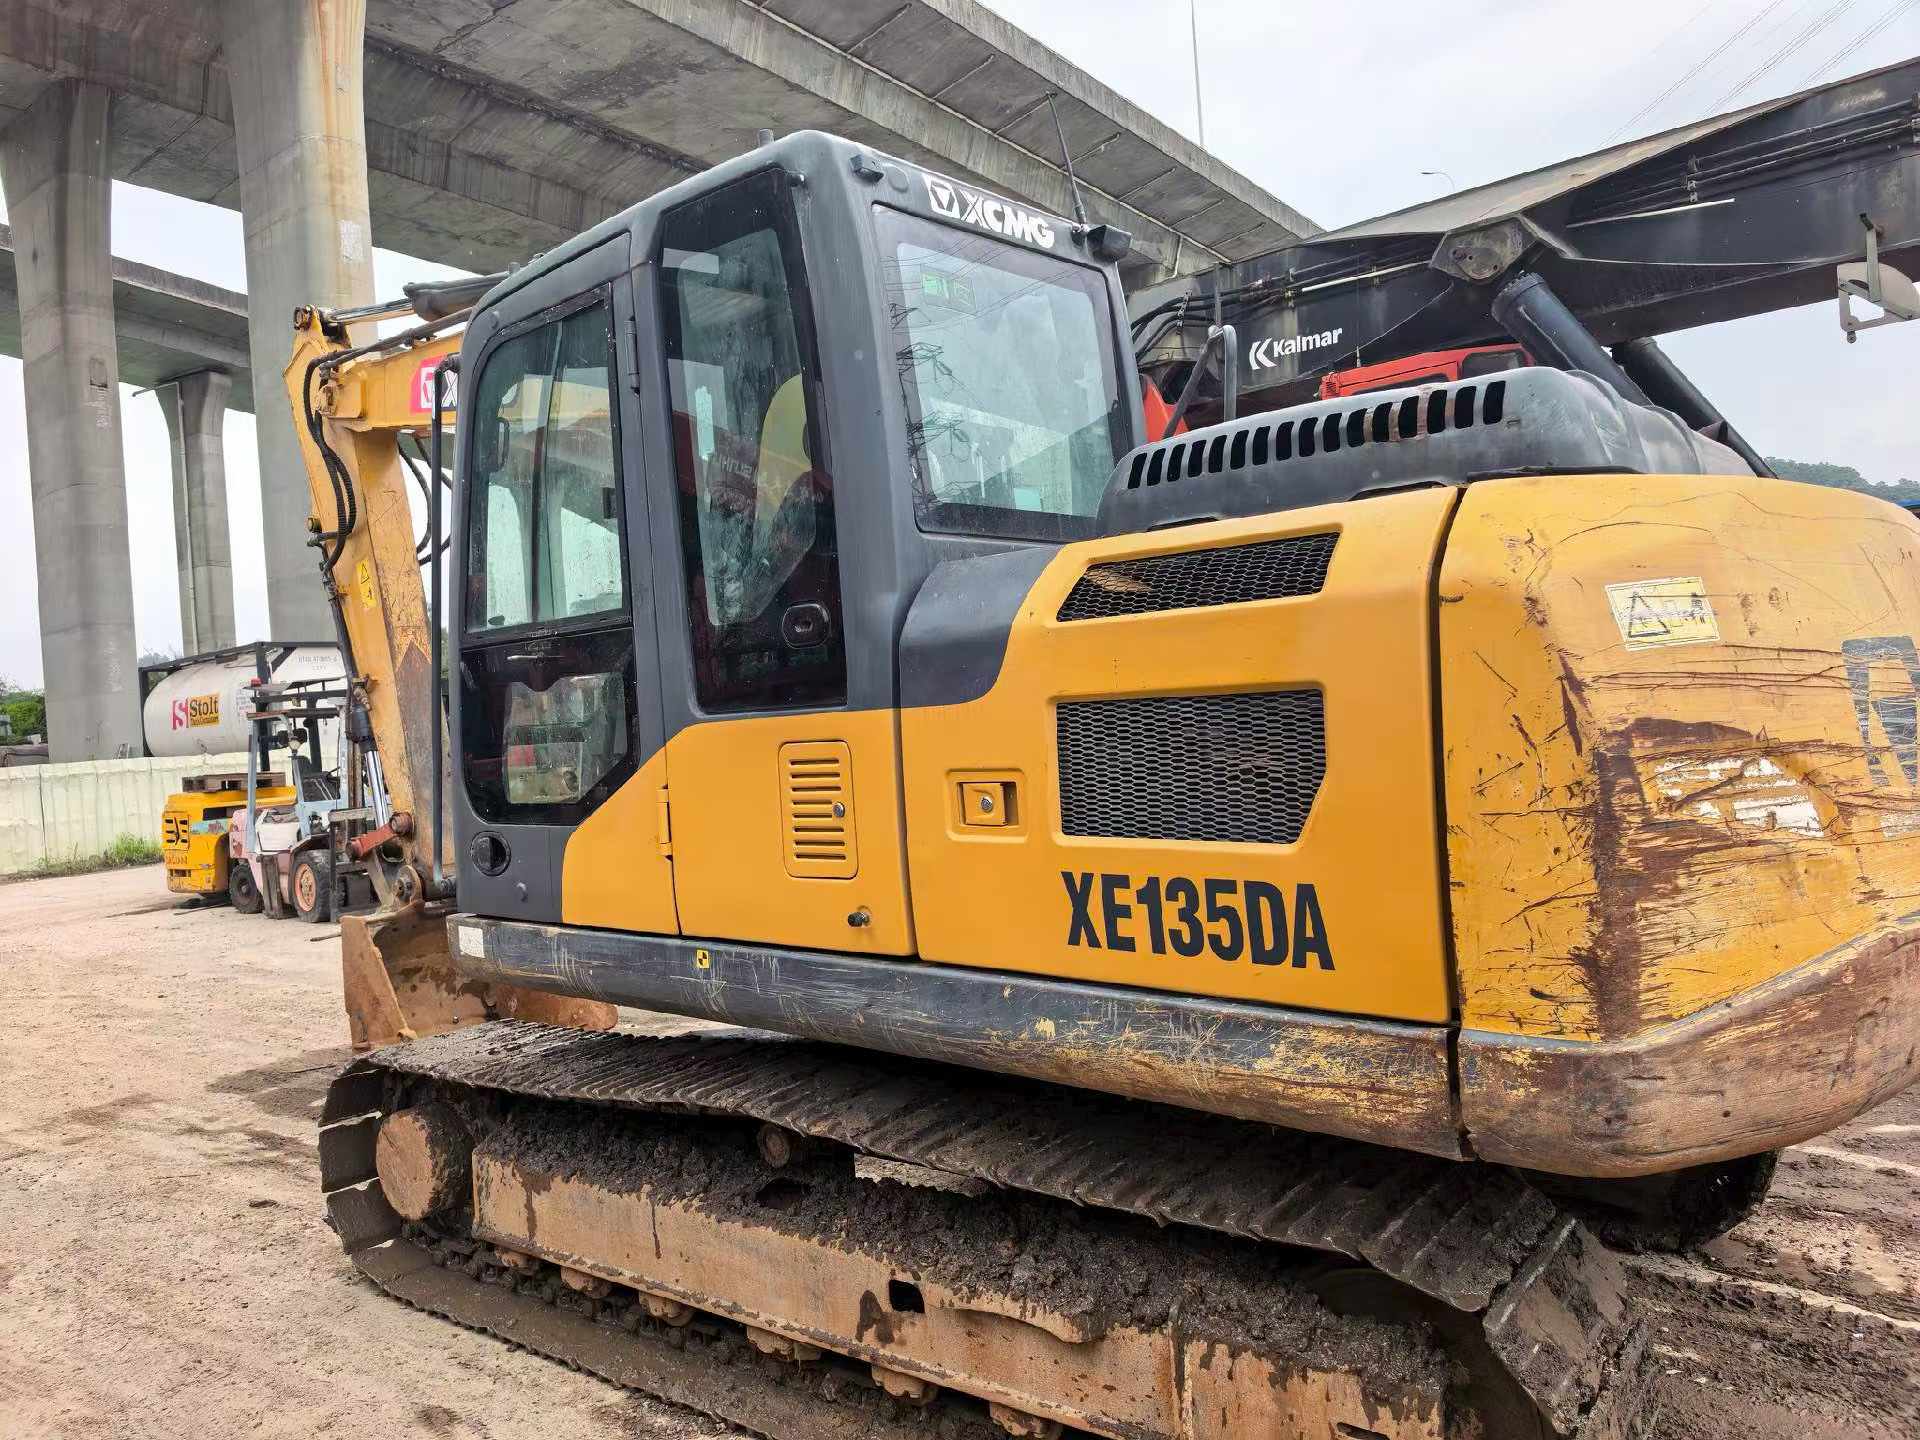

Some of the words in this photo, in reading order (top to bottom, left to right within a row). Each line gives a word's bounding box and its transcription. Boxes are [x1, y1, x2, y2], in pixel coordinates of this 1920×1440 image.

[960, 188, 1055, 249] XCMG
[1272, 328, 1343, 358] Kalmar
[190, 697, 219, 717] Stolt
[1061, 871, 1336, 970] XE135DA
